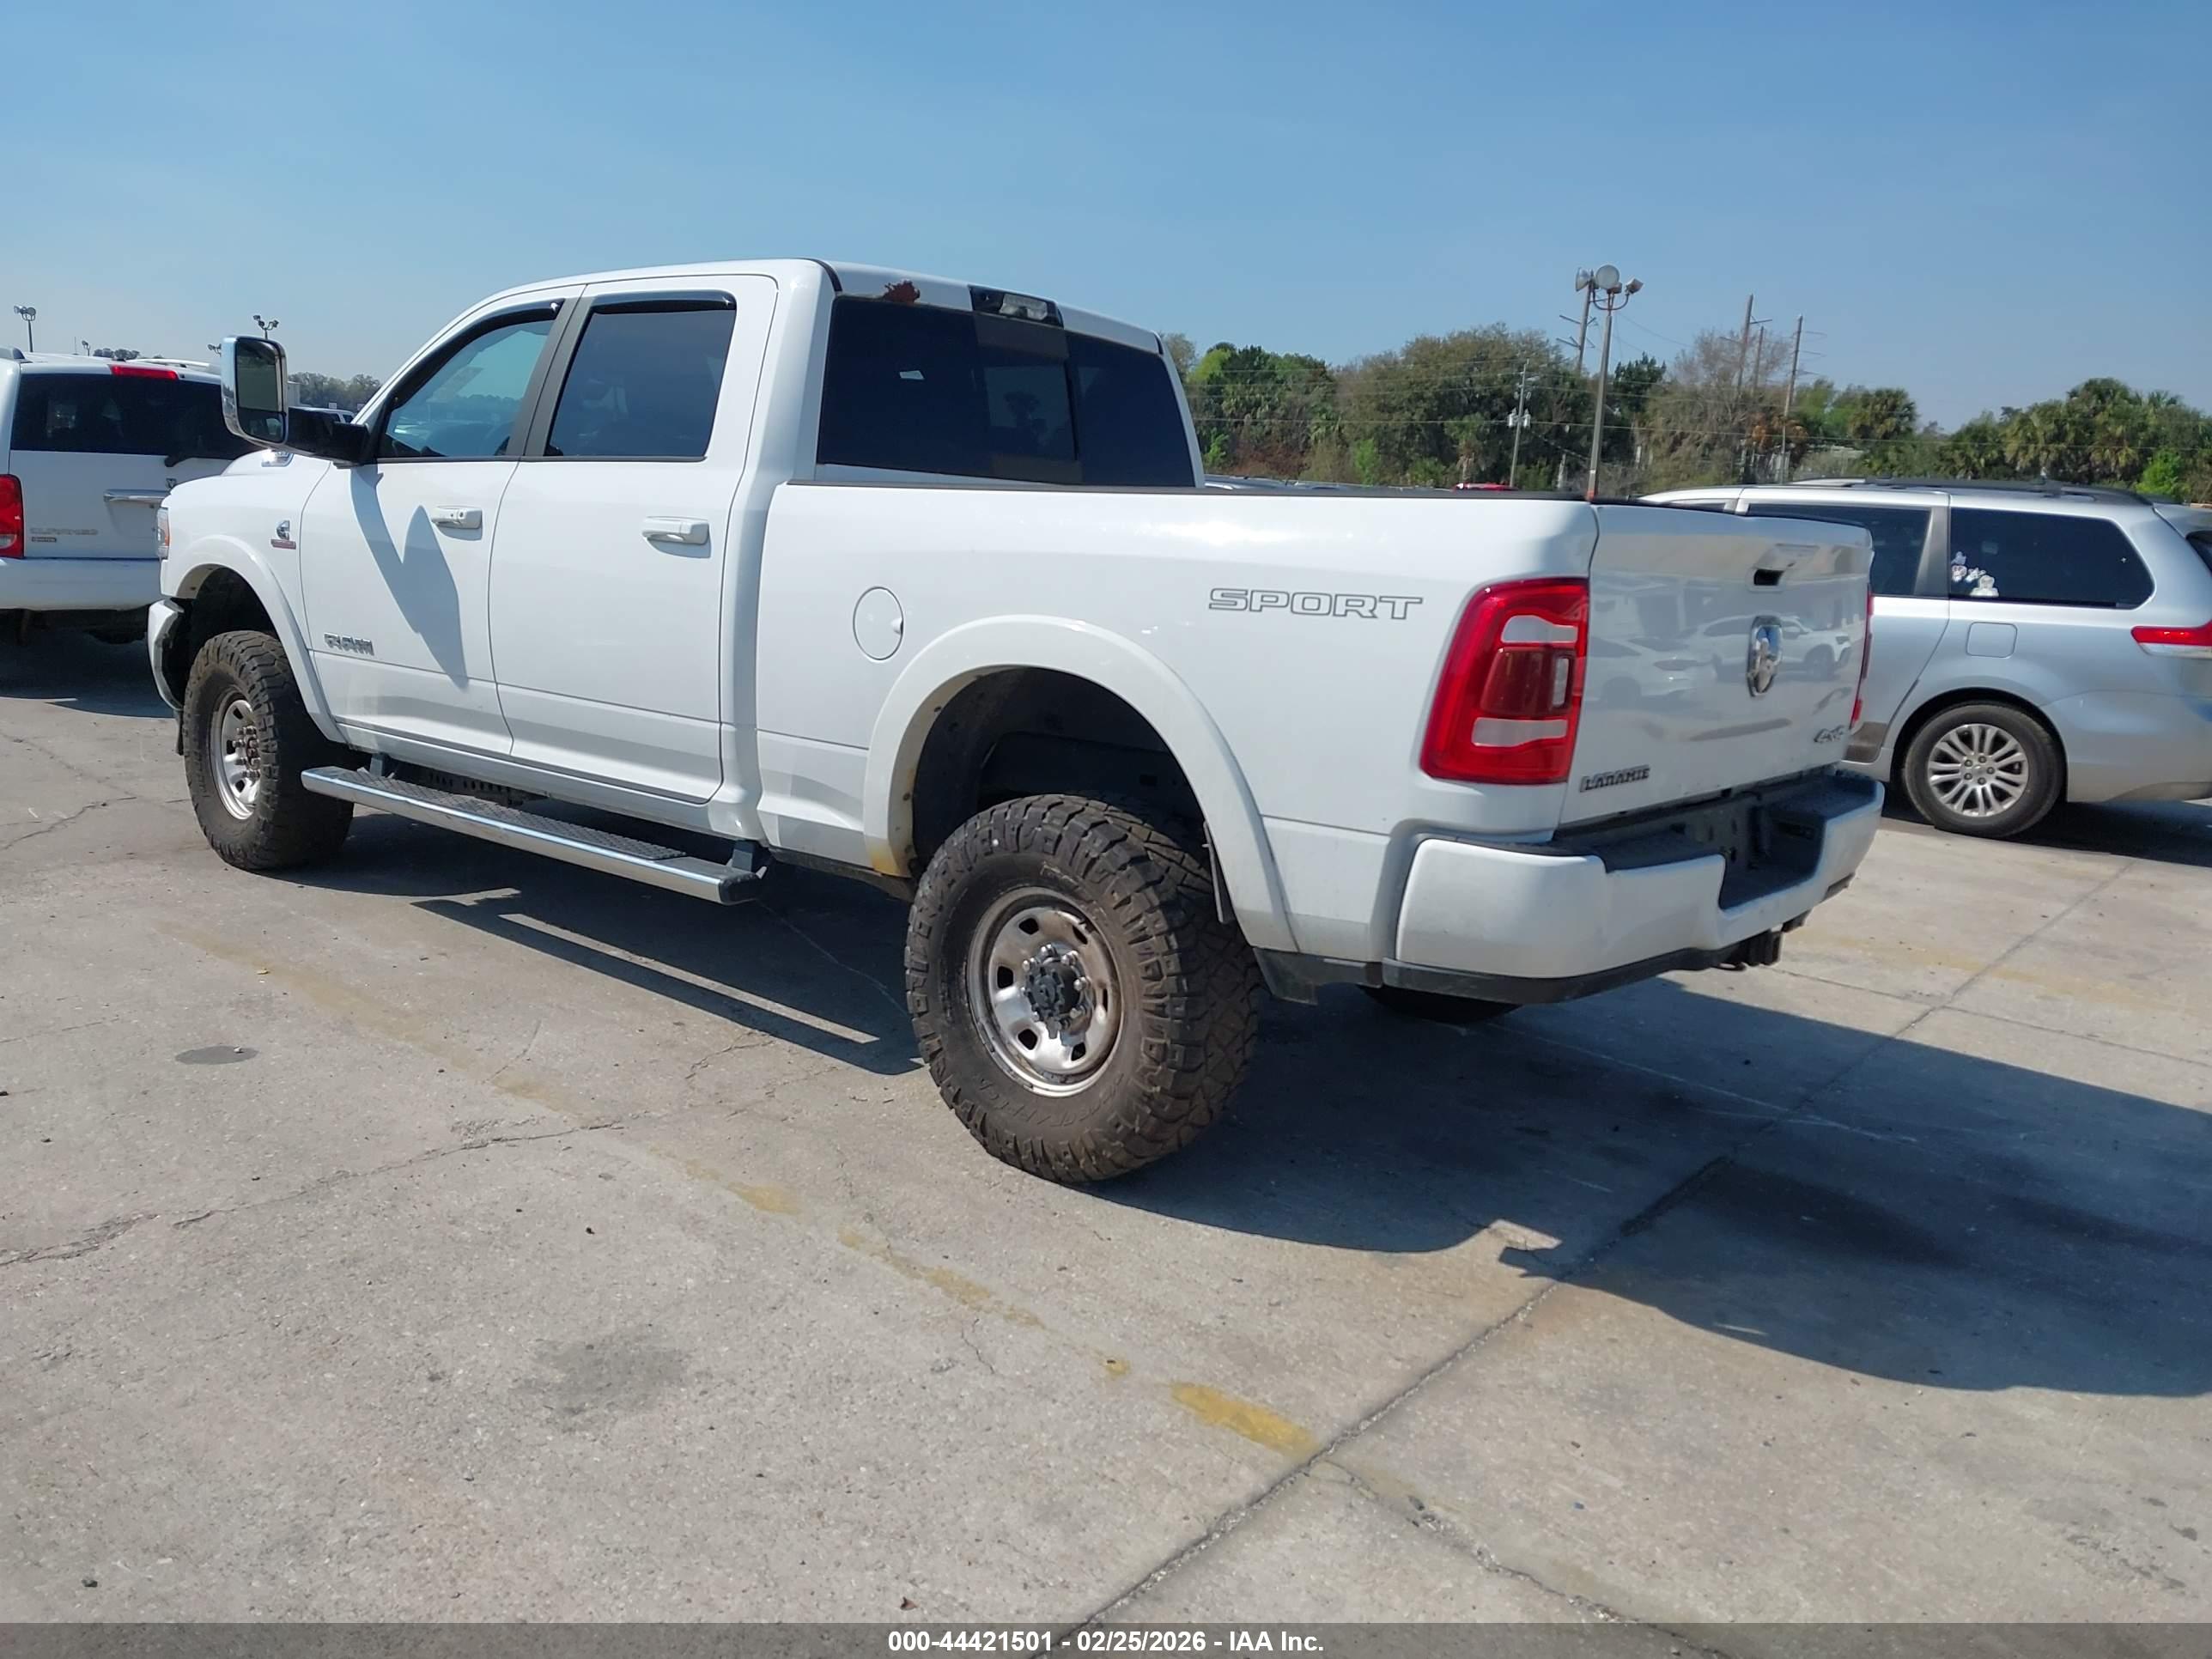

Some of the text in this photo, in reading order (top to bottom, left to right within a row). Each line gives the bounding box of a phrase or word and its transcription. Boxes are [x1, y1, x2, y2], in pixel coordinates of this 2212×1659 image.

[1209, 588, 1424, 620] SPORT
[324, 633, 374, 655] RAM
[1579, 764, 1650, 793] LARAMIE
